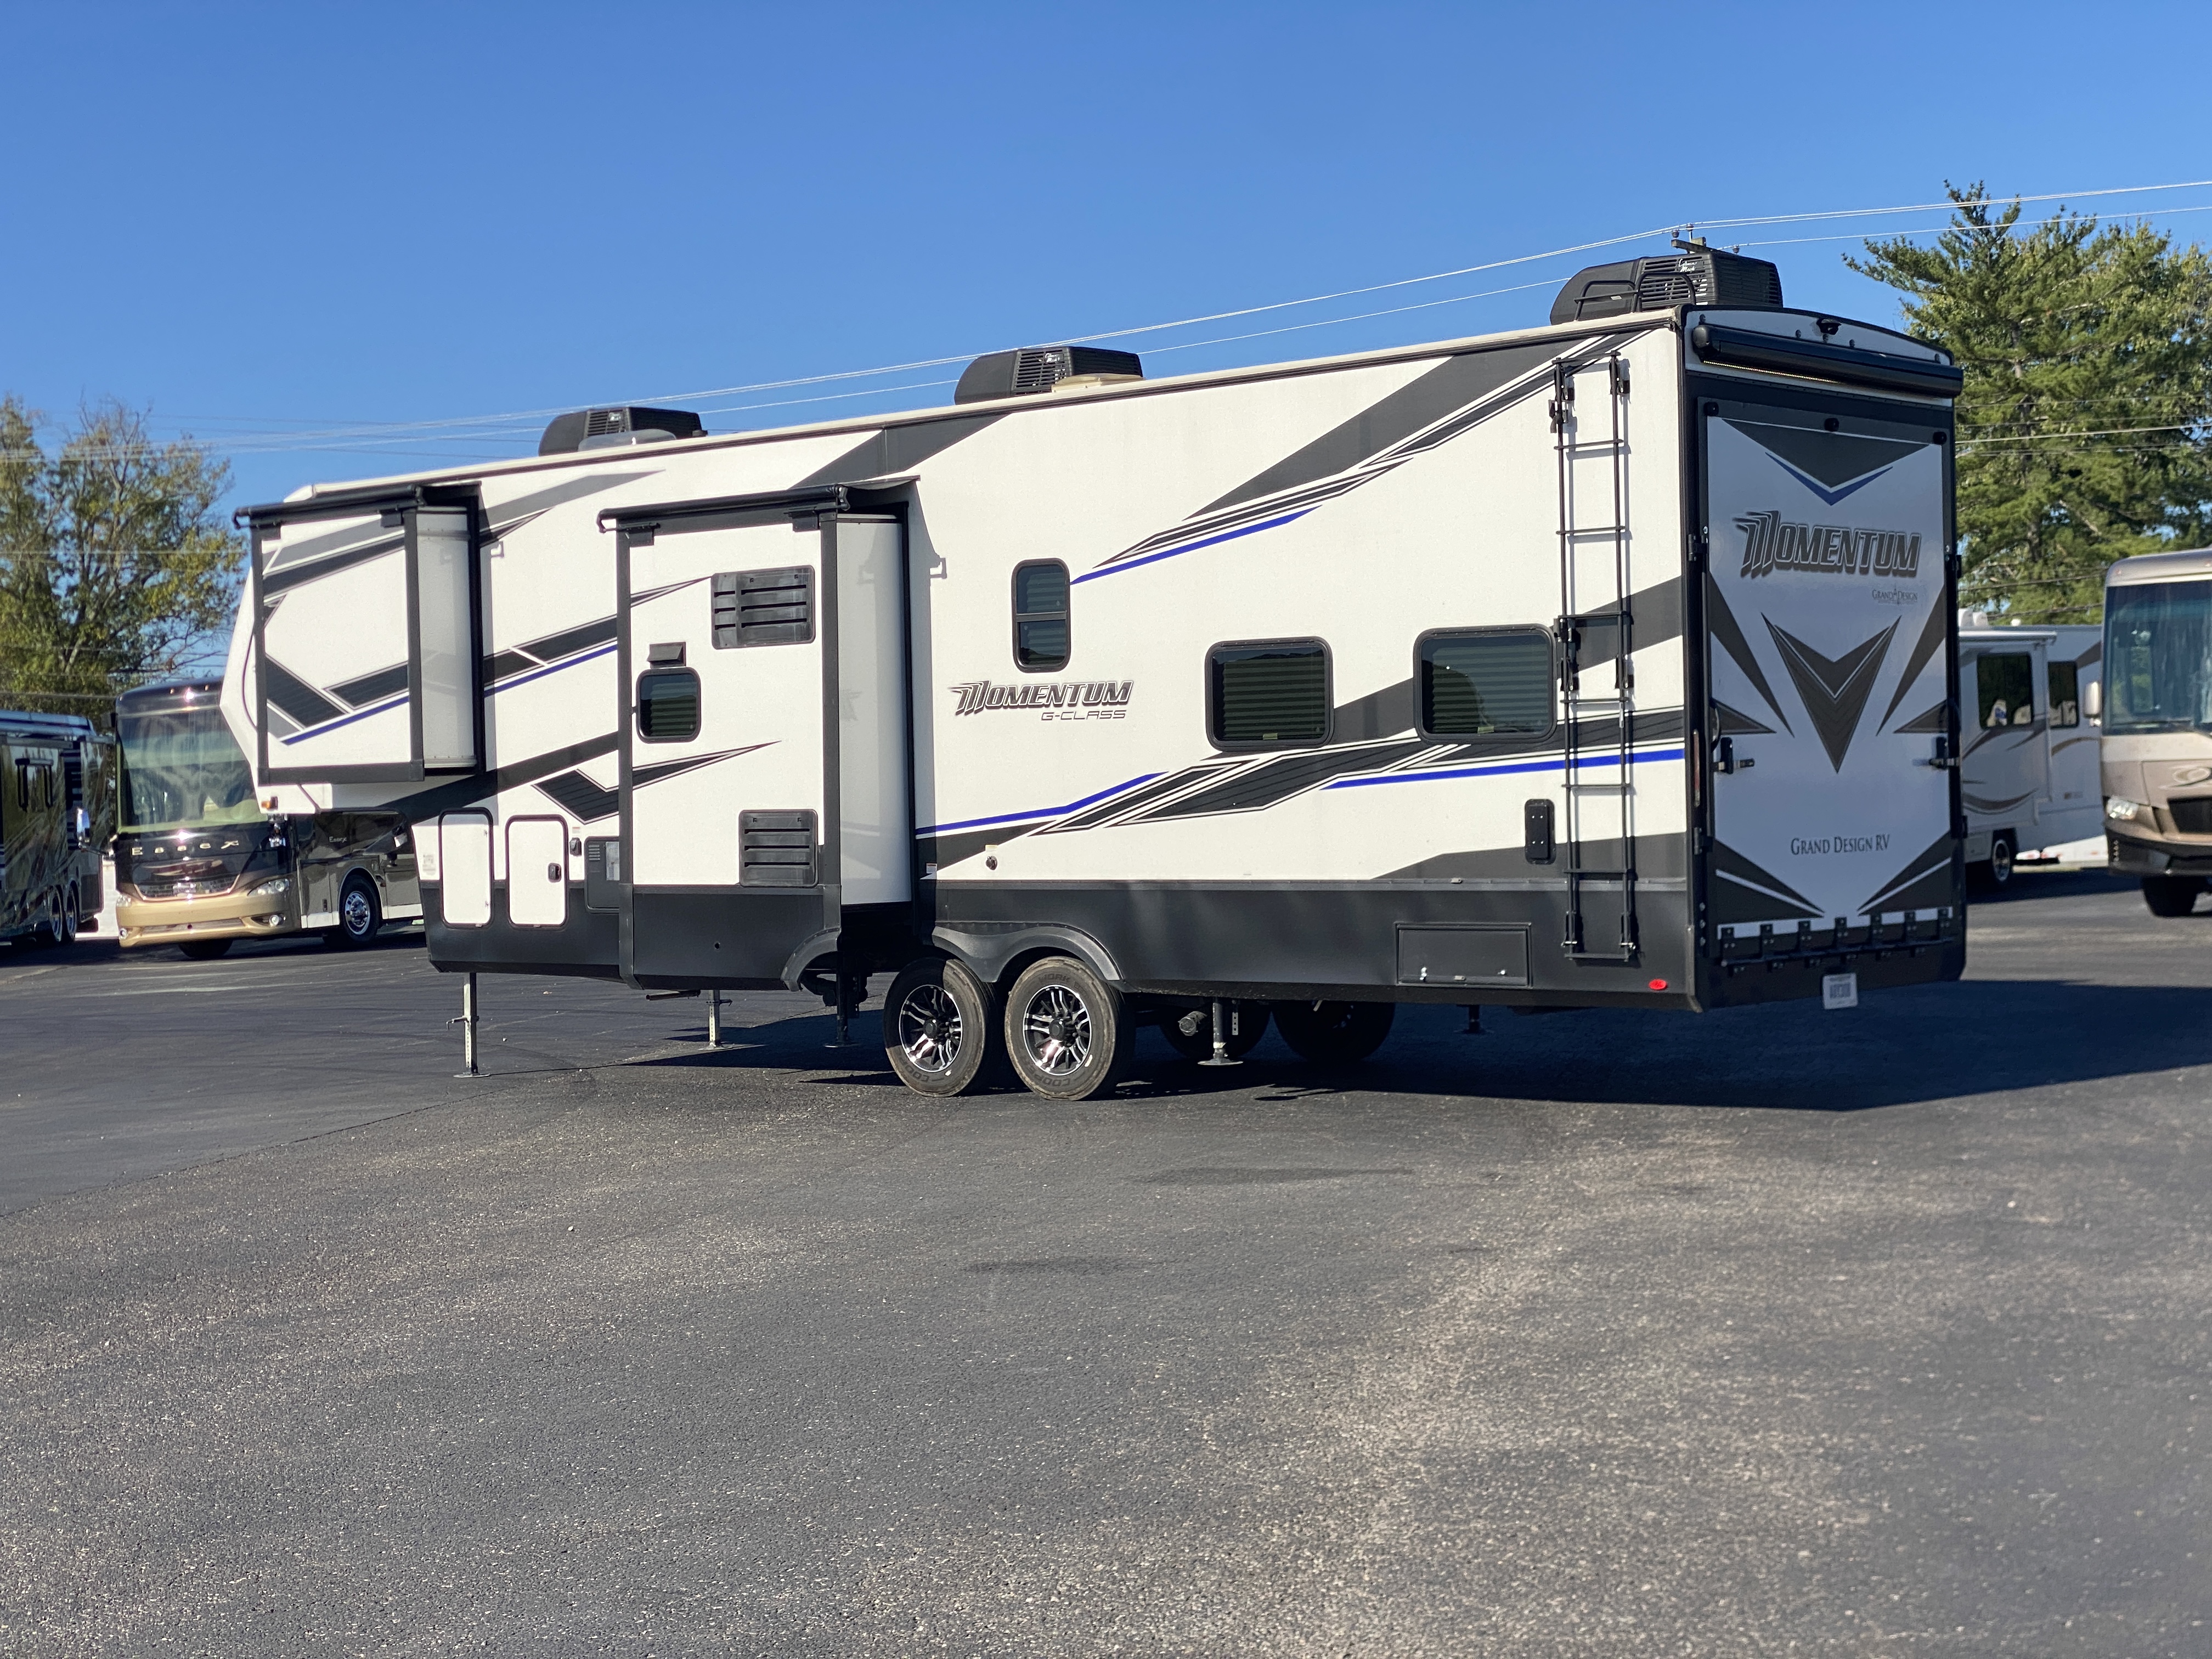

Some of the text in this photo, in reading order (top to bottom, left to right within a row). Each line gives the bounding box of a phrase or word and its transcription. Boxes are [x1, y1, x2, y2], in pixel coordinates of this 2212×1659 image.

[1732, 510, 1921, 579] MOMENTUM
[949, 680, 1133, 716] MOMENTUM
[1041, 709, 1127, 721] G-CLASS
[1790, 833, 1890, 855] GRAND DESIGN RV
